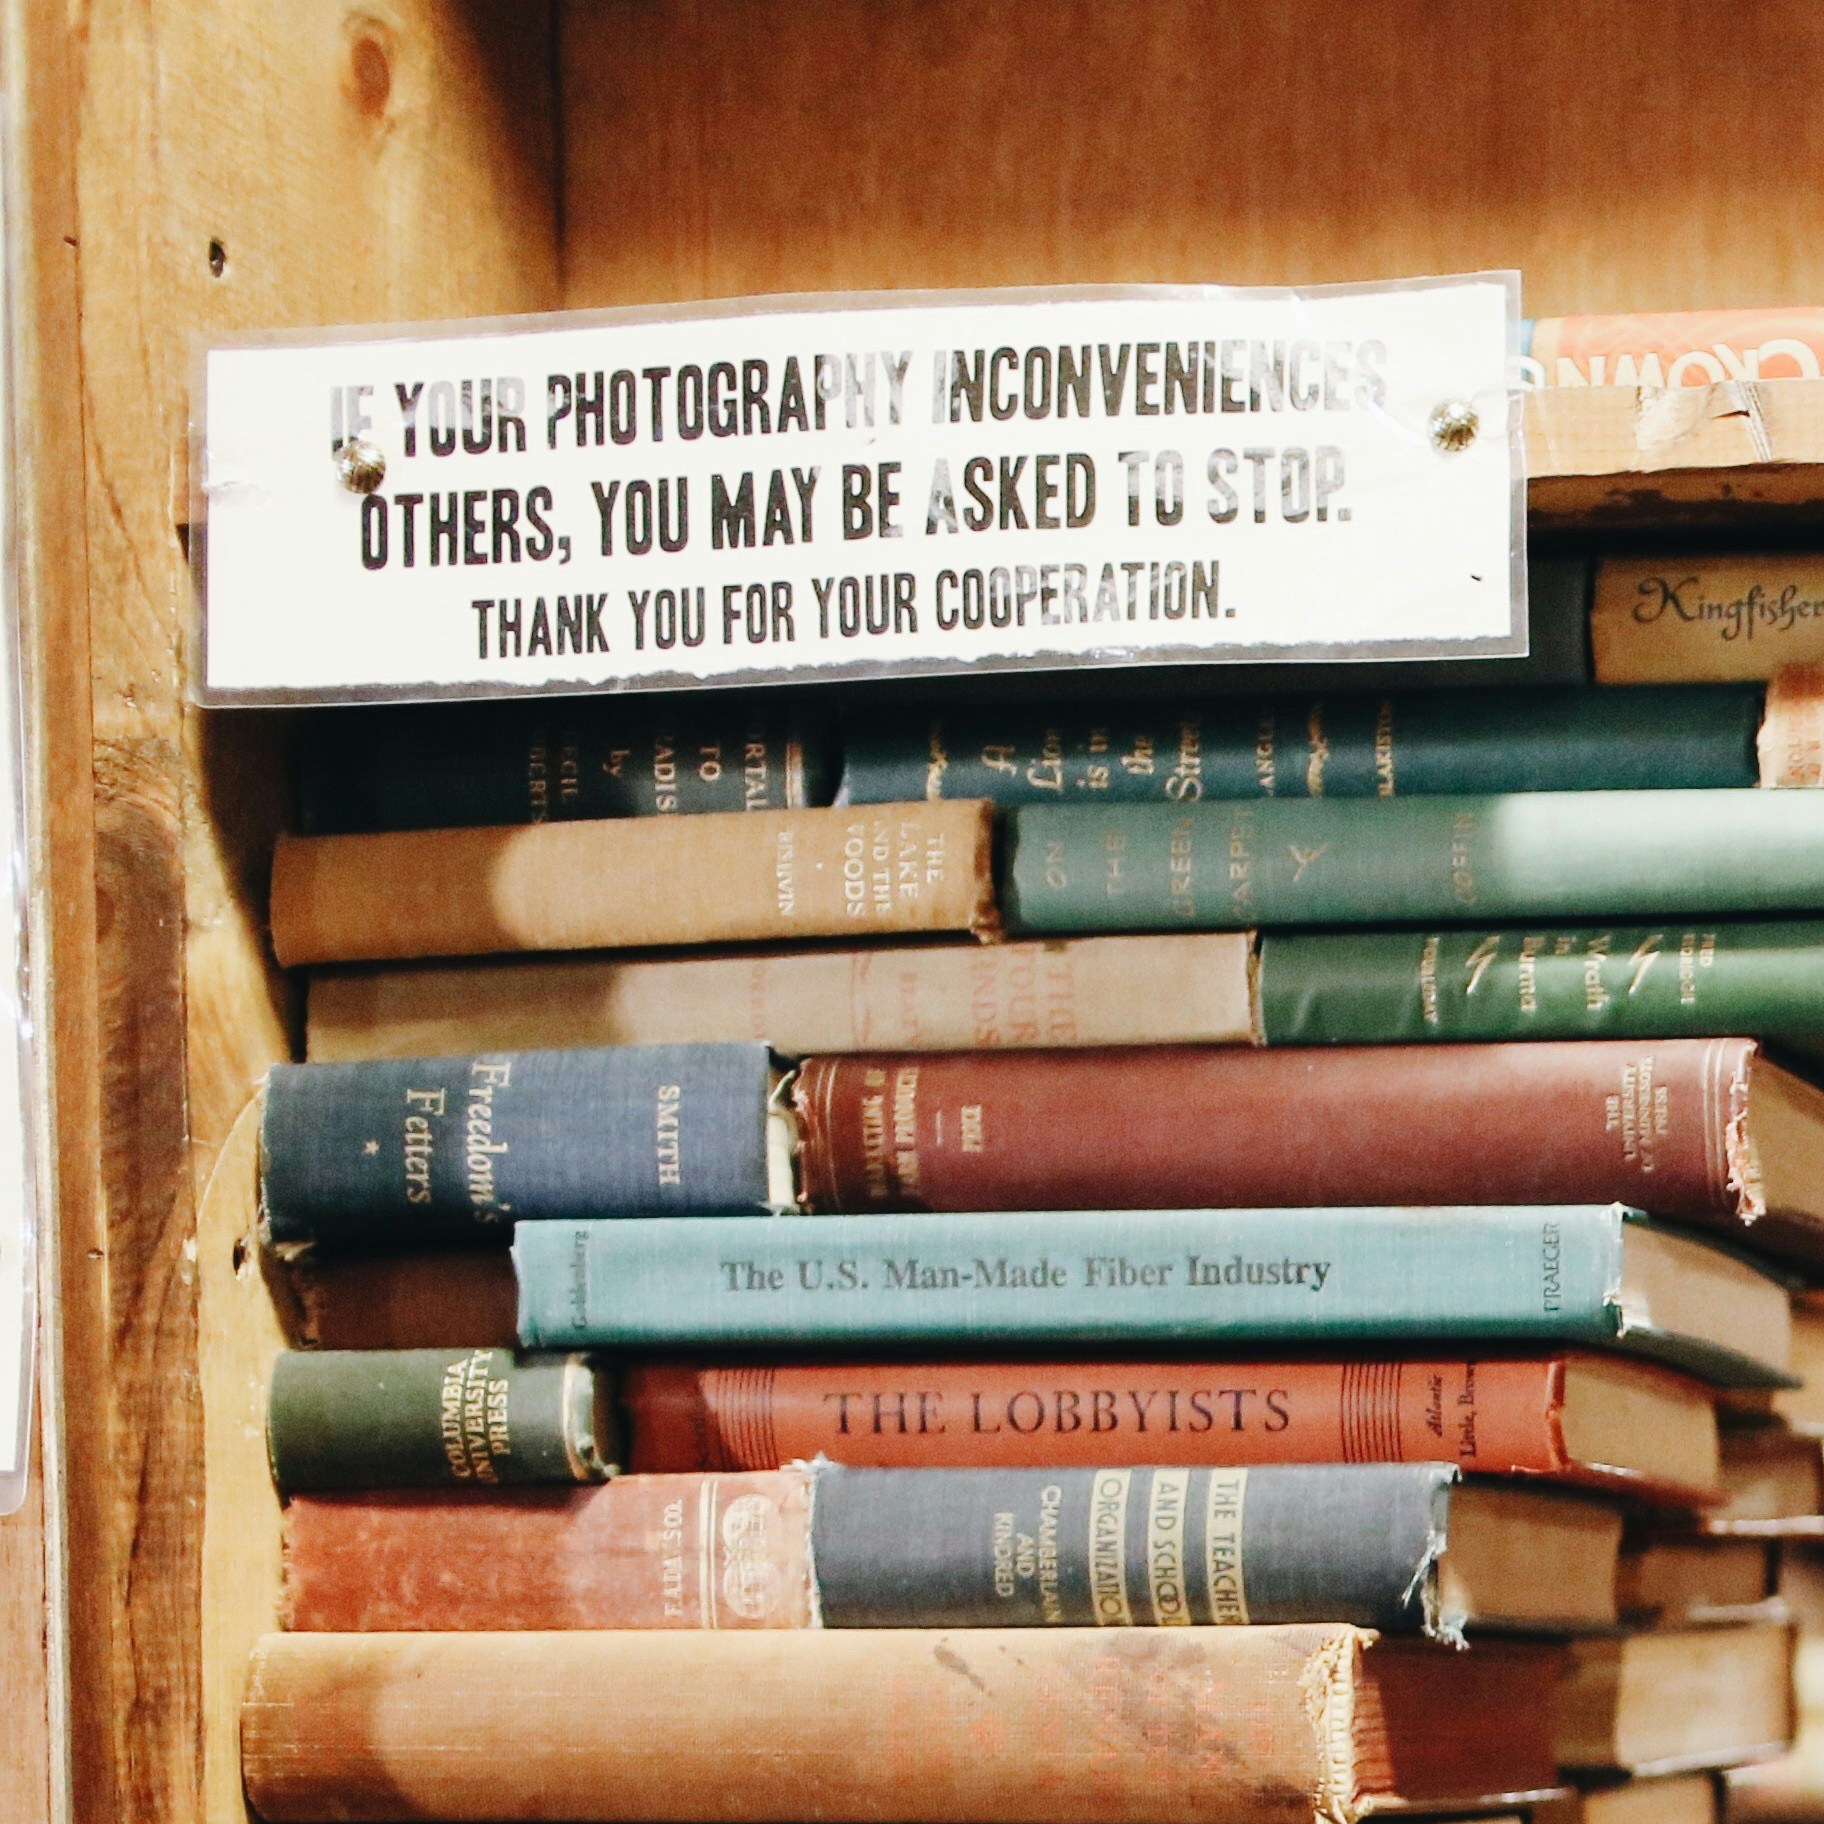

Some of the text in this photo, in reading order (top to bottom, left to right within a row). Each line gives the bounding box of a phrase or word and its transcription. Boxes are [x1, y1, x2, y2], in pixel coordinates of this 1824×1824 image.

[394, 374, 527, 460] YOUR
[546, 346, 915, 455] PHOTOGRAPHY
[931, 337, 1389, 429] INCONVENIENCES
[359, 442, 1352, 570] OTHERS, YOU MAY BE ASKED TO STOP.
[472, 557, 1238, 661] THANK YOU FOR YOUR COOPERATION.
[404, 1089, 446, 1204] Fetters
[466, 1061, 513, 1224] Freedom's
[657, 1085, 681, 1186] SMITH
[723, 1255, 1331, 1294] The U.S. Man-Made Fiber Industry
[1544, 1221, 1563, 1313] PRAEGER
[441, 1356, 470, 1481] COLUMBIA
[490, 1377, 511, 1456] PRESS
[823, 1388, 1292, 1437] THE LOBBYISTS
[994, 1509, 1014, 1598] KINDRED
[1015, 1531, 1035, 1578] AND
